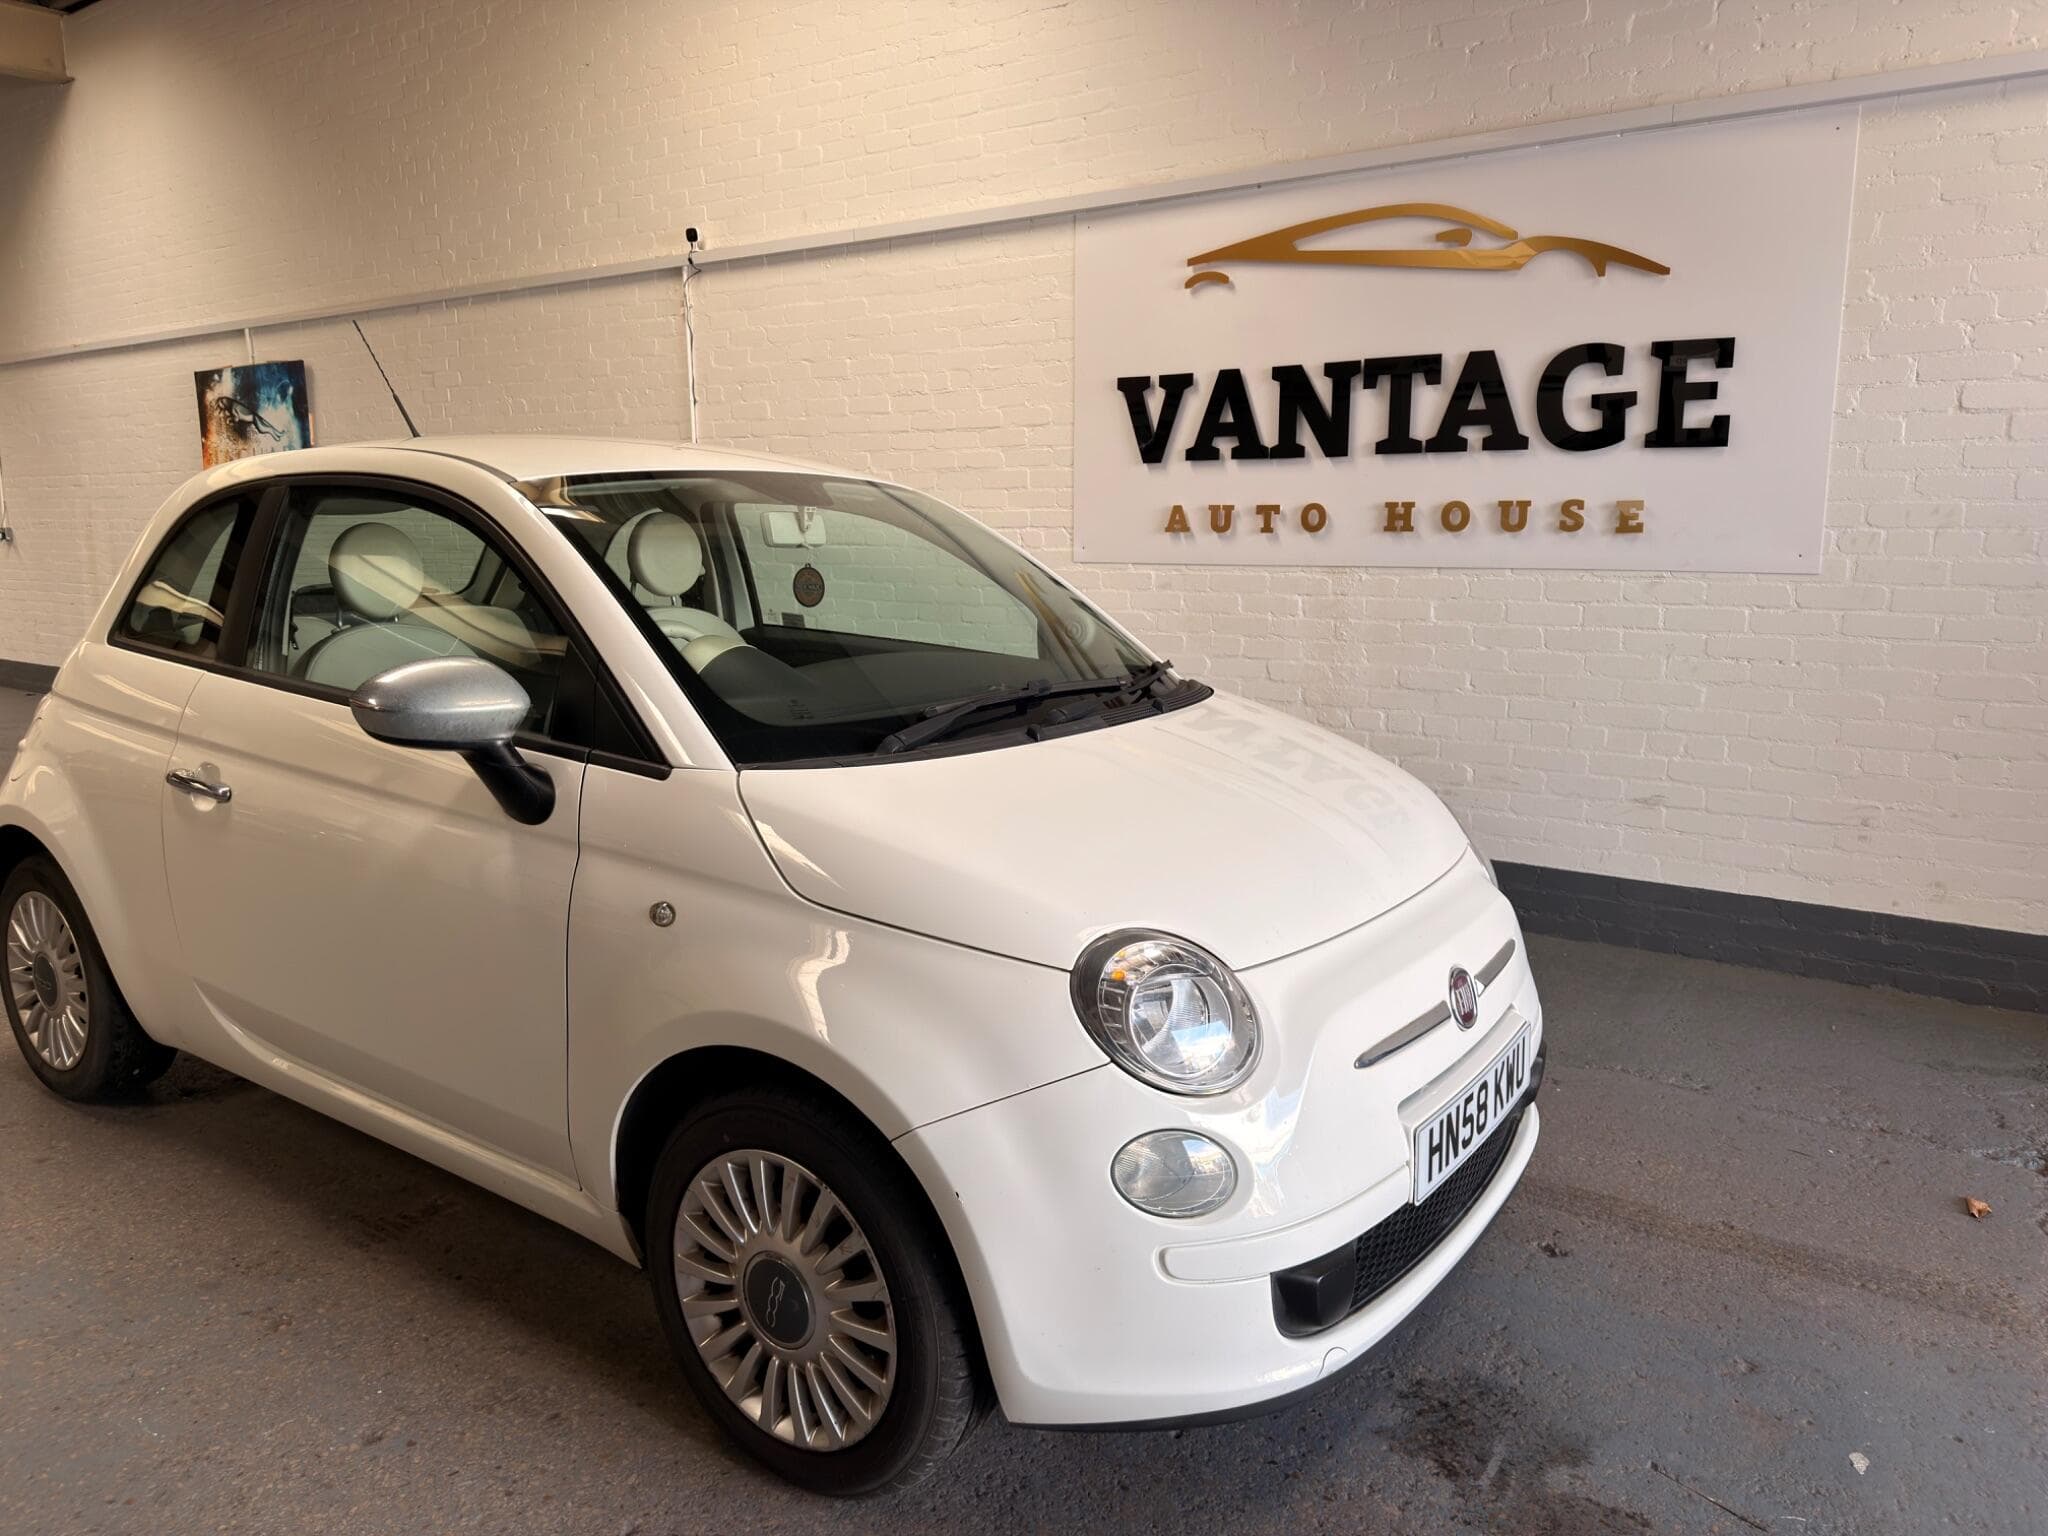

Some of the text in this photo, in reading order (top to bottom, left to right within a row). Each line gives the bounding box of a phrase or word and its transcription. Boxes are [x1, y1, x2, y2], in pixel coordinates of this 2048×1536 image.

[1117, 336, 1736, 464] VANTAGE
[1163, 498, 1646, 535] AUTO HOUSE
[1427, 1035, 1526, 1185] HN58 KWU
